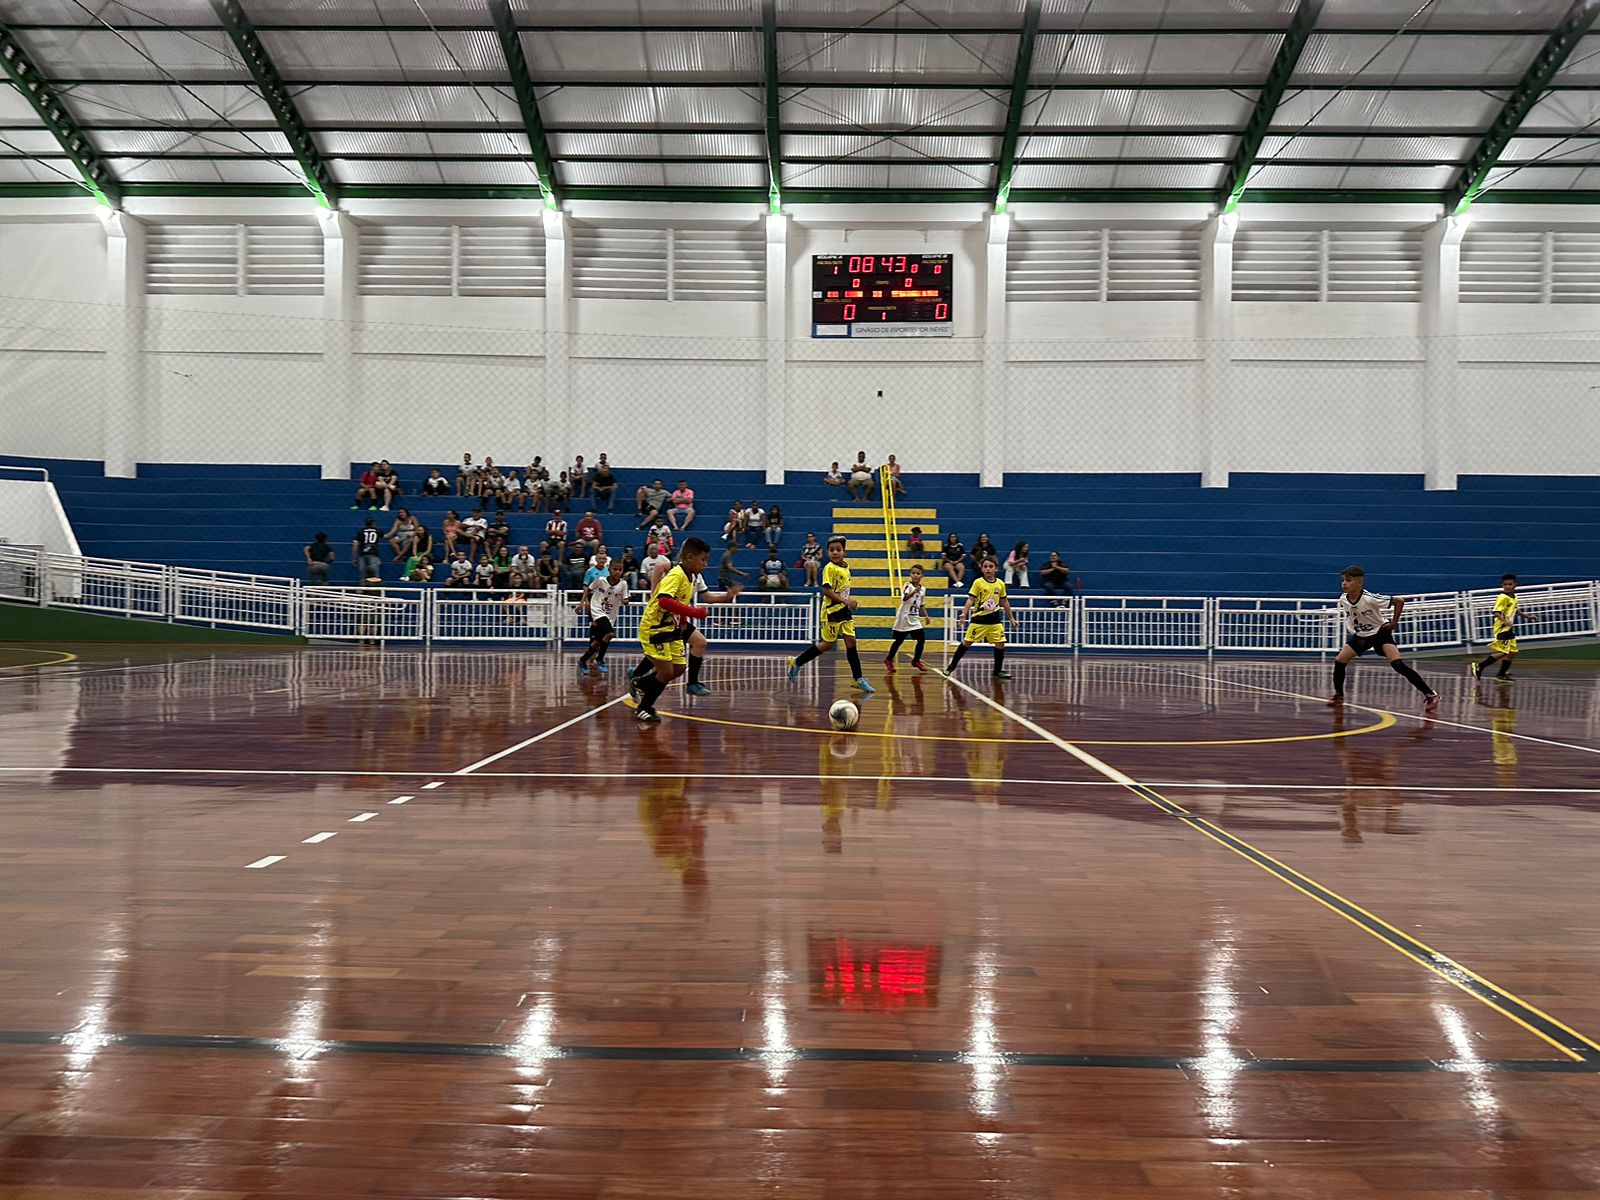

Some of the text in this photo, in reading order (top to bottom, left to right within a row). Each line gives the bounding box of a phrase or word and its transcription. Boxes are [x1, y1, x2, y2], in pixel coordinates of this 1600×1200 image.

[848, 256, 907, 272] 08 43
[834, 266, 838, 274] 1
[852, 278, 860, 288] 0
[844, 304, 856, 320] 0
[882, 312, 886, 320] 1
[935, 304, 948, 319] 0
[363, 532, 378, 543] 10
